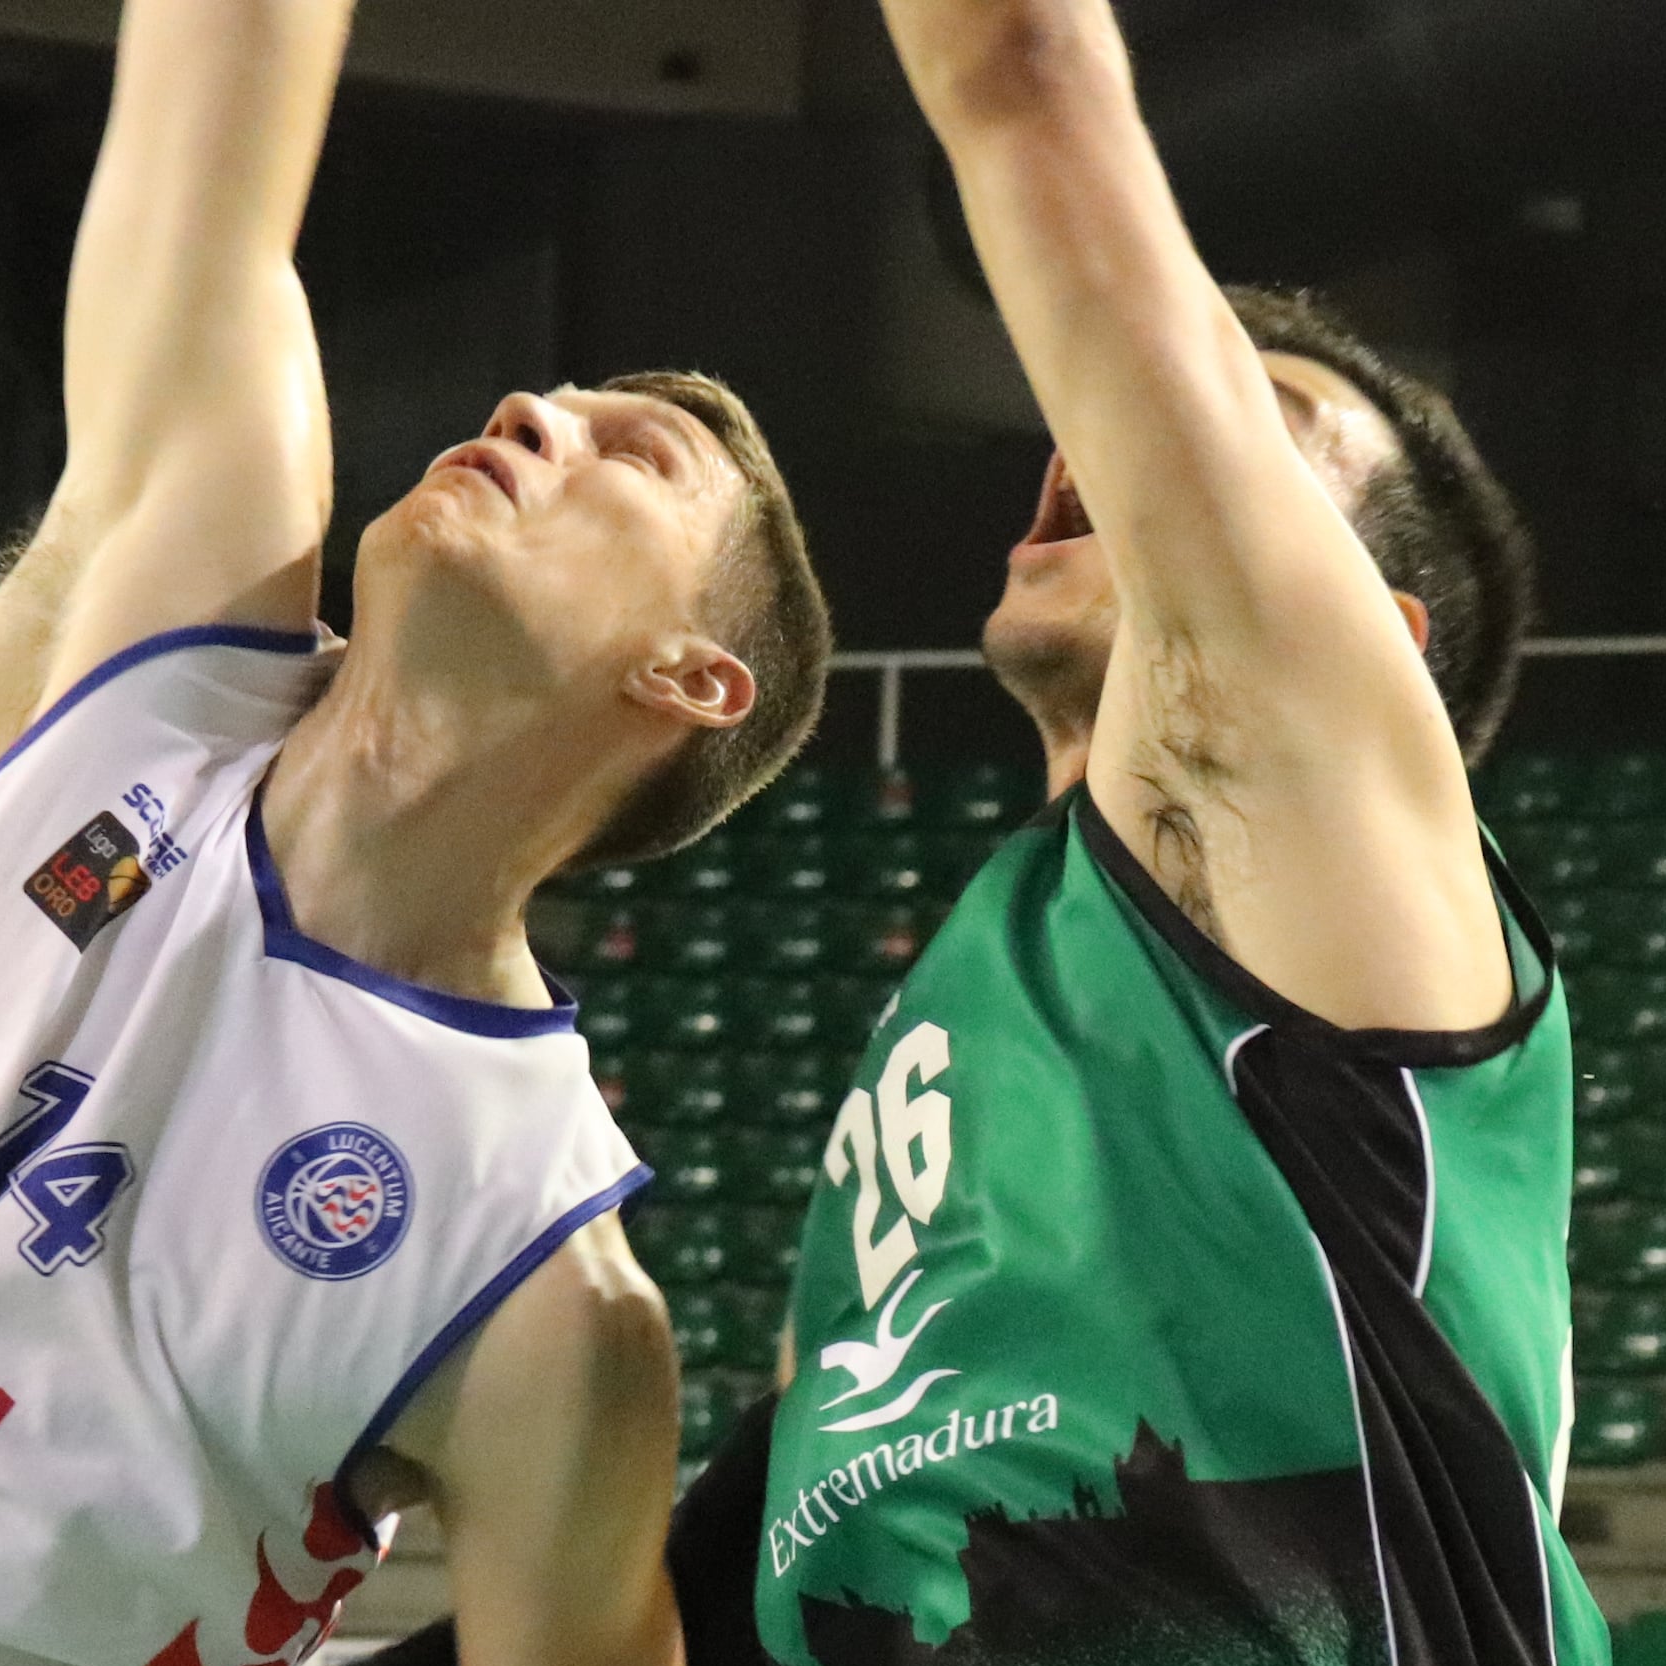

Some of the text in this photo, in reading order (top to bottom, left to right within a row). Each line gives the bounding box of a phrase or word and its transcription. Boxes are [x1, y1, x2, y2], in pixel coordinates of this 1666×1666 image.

[51, 852, 102, 902] LEB
[84, 823, 119, 860] Liga
[33, 873, 77, 917] ORO
[327, 1132, 405, 1218] LUCENTUM
[823, 1020, 952, 1312] 26
[265, 1190, 333, 1269] ALICANTE
[768, 1392, 1059, 1578] Extremadura
